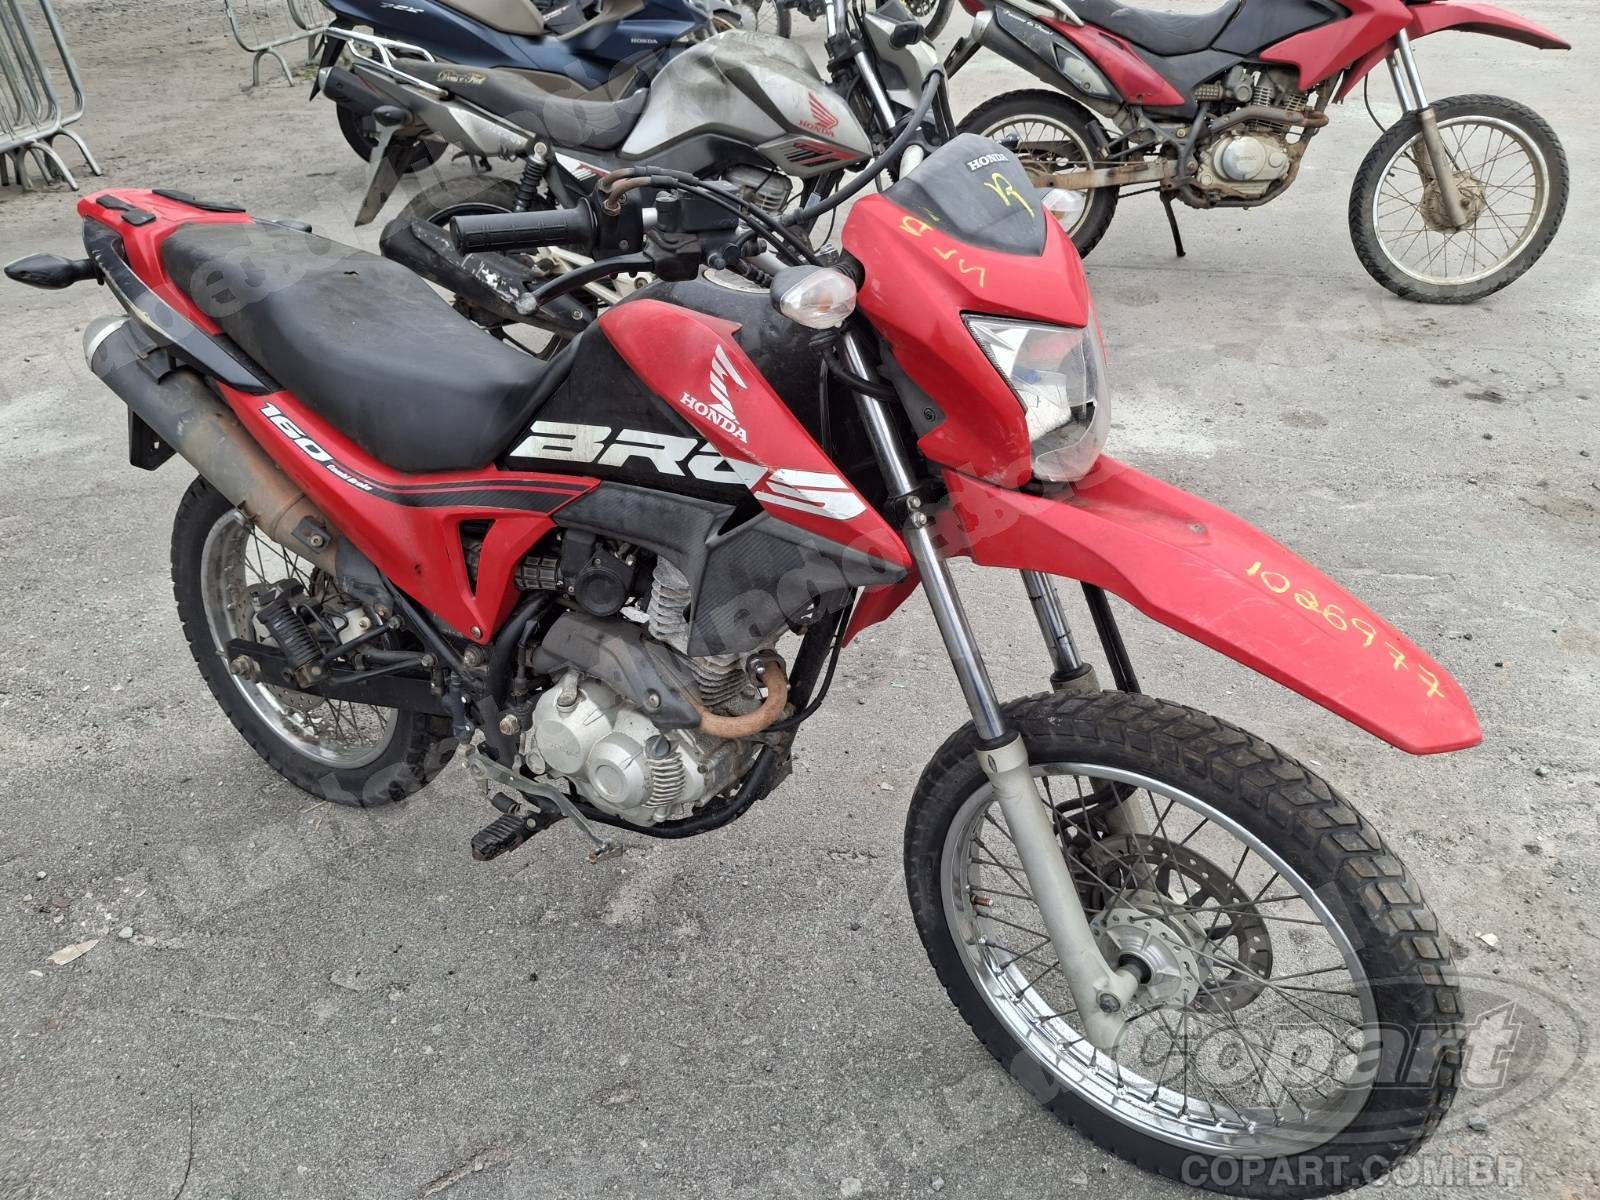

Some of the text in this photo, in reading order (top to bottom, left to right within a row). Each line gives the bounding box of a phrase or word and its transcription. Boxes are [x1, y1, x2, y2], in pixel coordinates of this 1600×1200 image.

[799, 120, 835, 137] HONDA
[967, 153, 1009, 171] HONDA
[260, 402, 334, 462] 160
[679, 391, 748, 444] HONDA
[508, 420, 866, 520] BROS
